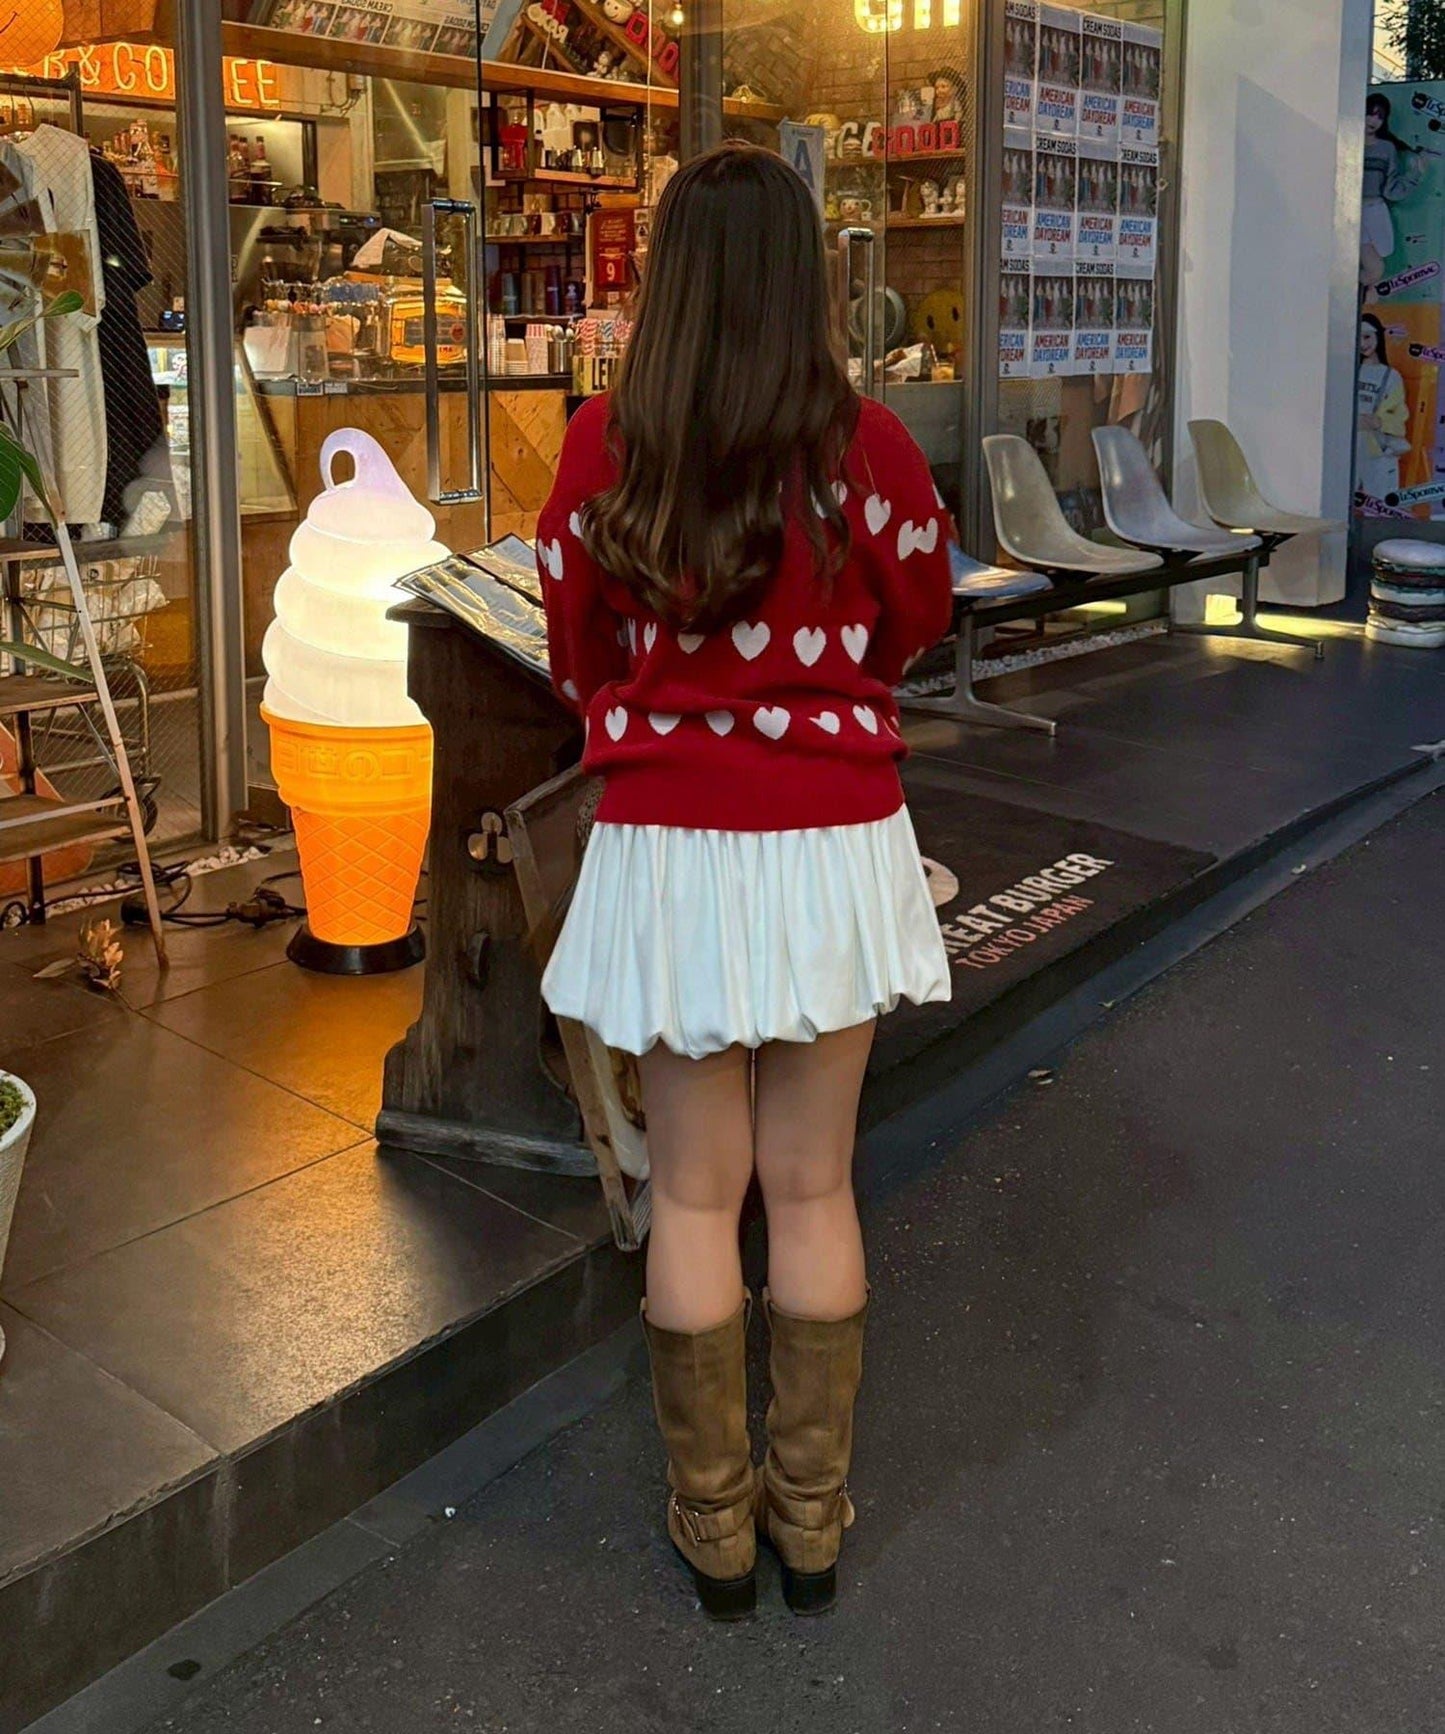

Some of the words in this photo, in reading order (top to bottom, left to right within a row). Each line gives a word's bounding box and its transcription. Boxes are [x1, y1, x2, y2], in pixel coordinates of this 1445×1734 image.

[78, 45, 100, 85] &
[1040, 87, 1075, 106] AMERICAN
[1084, 95, 1116, 111] AMERICAN
[1038, 102, 1075, 119] DAYDREAM
[1124, 99, 1155, 116] AMERICAN
[1082, 109, 1116, 126] DAYDREAM
[1037, 213, 1071, 228] AMERICAN
[1081, 216, 1113, 231] AMERICAN
[1120, 219, 1152, 233] AMERICAN
[1035, 227, 1071, 242] DAYDREAM
[1079, 230, 1113, 244] DAYDREAM
[606, 263, 615, 281] 9
[1096, 263, 1113, 275] SODAS
[1035, 334, 1069, 348] AMERICAN
[1077, 333, 1109, 346] AMERICAN
[1117, 333, 1148, 346] AMERICAN
[1033, 349, 1069, 362] DAYDREAM
[1075, 347, 1109, 360] DAYDREAM
[989, 853, 1114, 913] BURGER
[955, 928, 1037, 968] TOKYO
[1023, 895, 1094, 933] JAPAN
